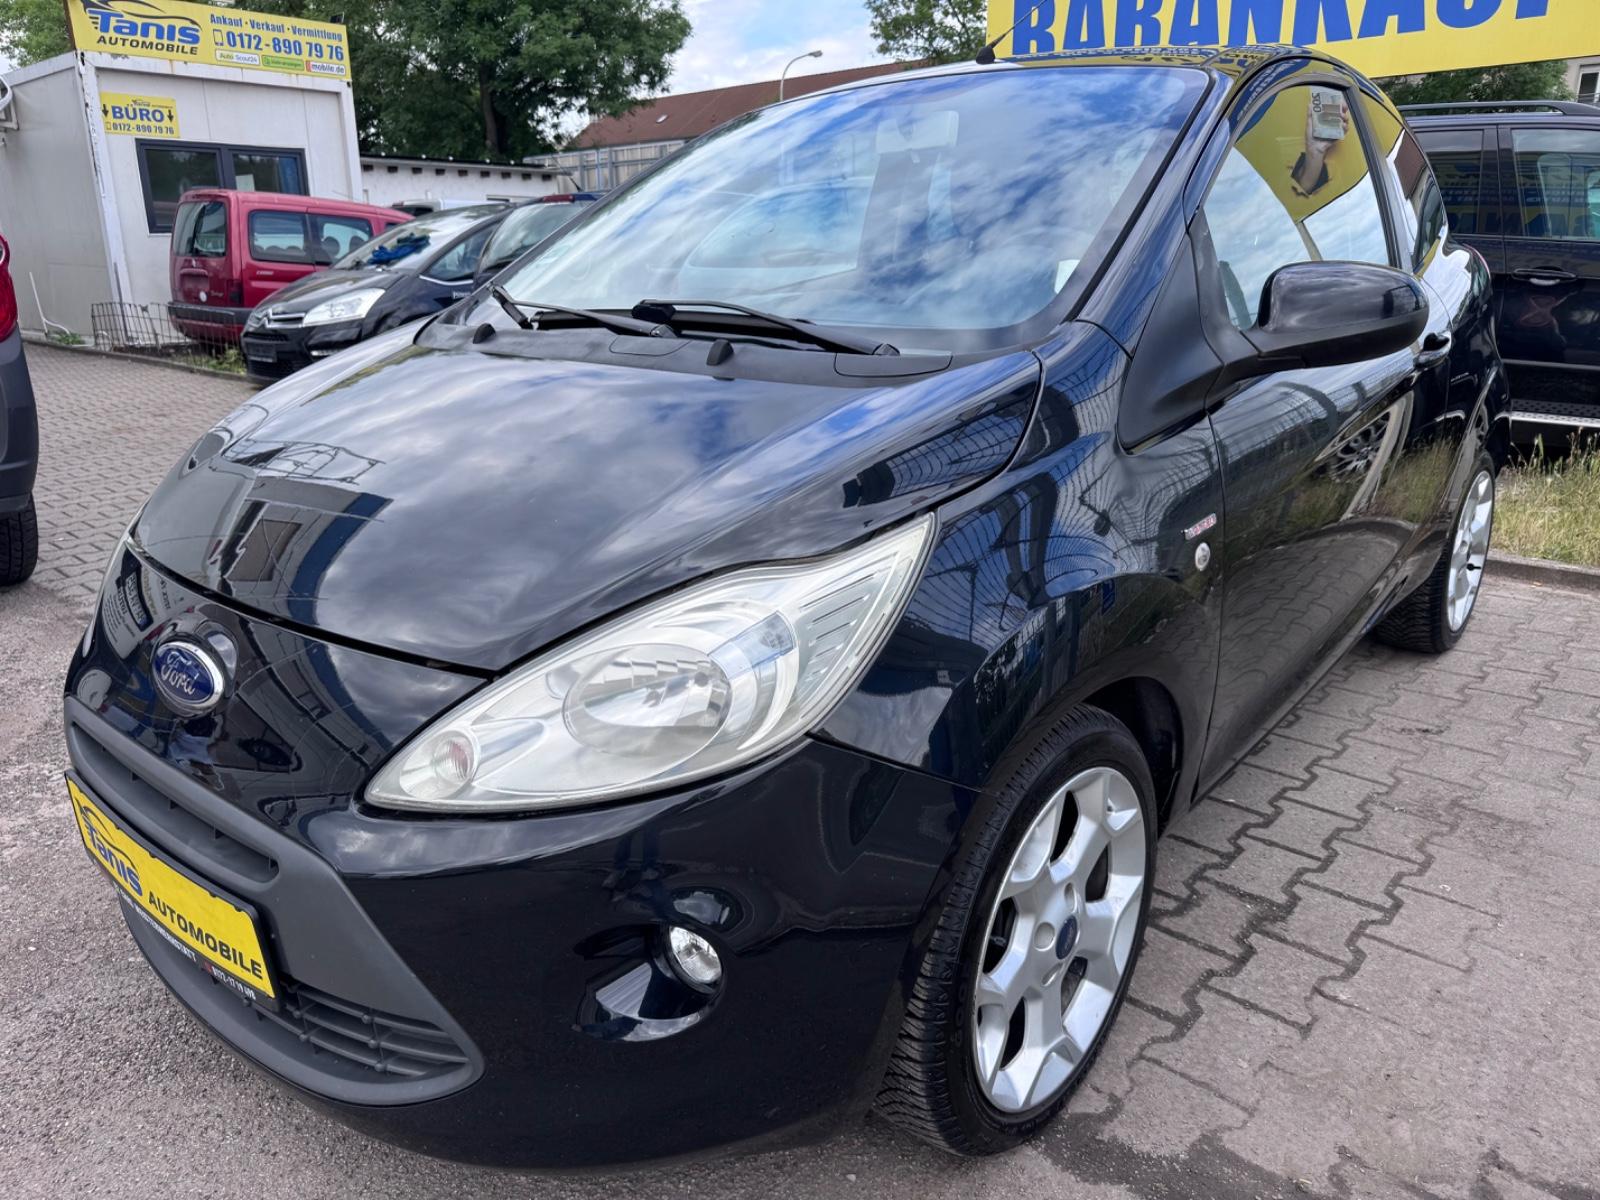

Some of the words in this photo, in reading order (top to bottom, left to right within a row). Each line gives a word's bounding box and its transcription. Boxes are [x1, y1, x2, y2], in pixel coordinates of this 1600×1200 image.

[210, 14, 243, 28] Ankauf
[249, 19, 285, 33] Verkauf
[291, 25, 343, 42] Vermittlung
[1011, 0, 1547, 55] BARAN
[97, 35, 198, 55] AUTOMOBILE
[306, 42, 323, 58] 79
[327, 45, 344, 61] 76
[111, 104, 164, 122] BÜRO
[161, 651, 199, 695] Ford
[149, 890, 264, 981] AUTOMOBILE
